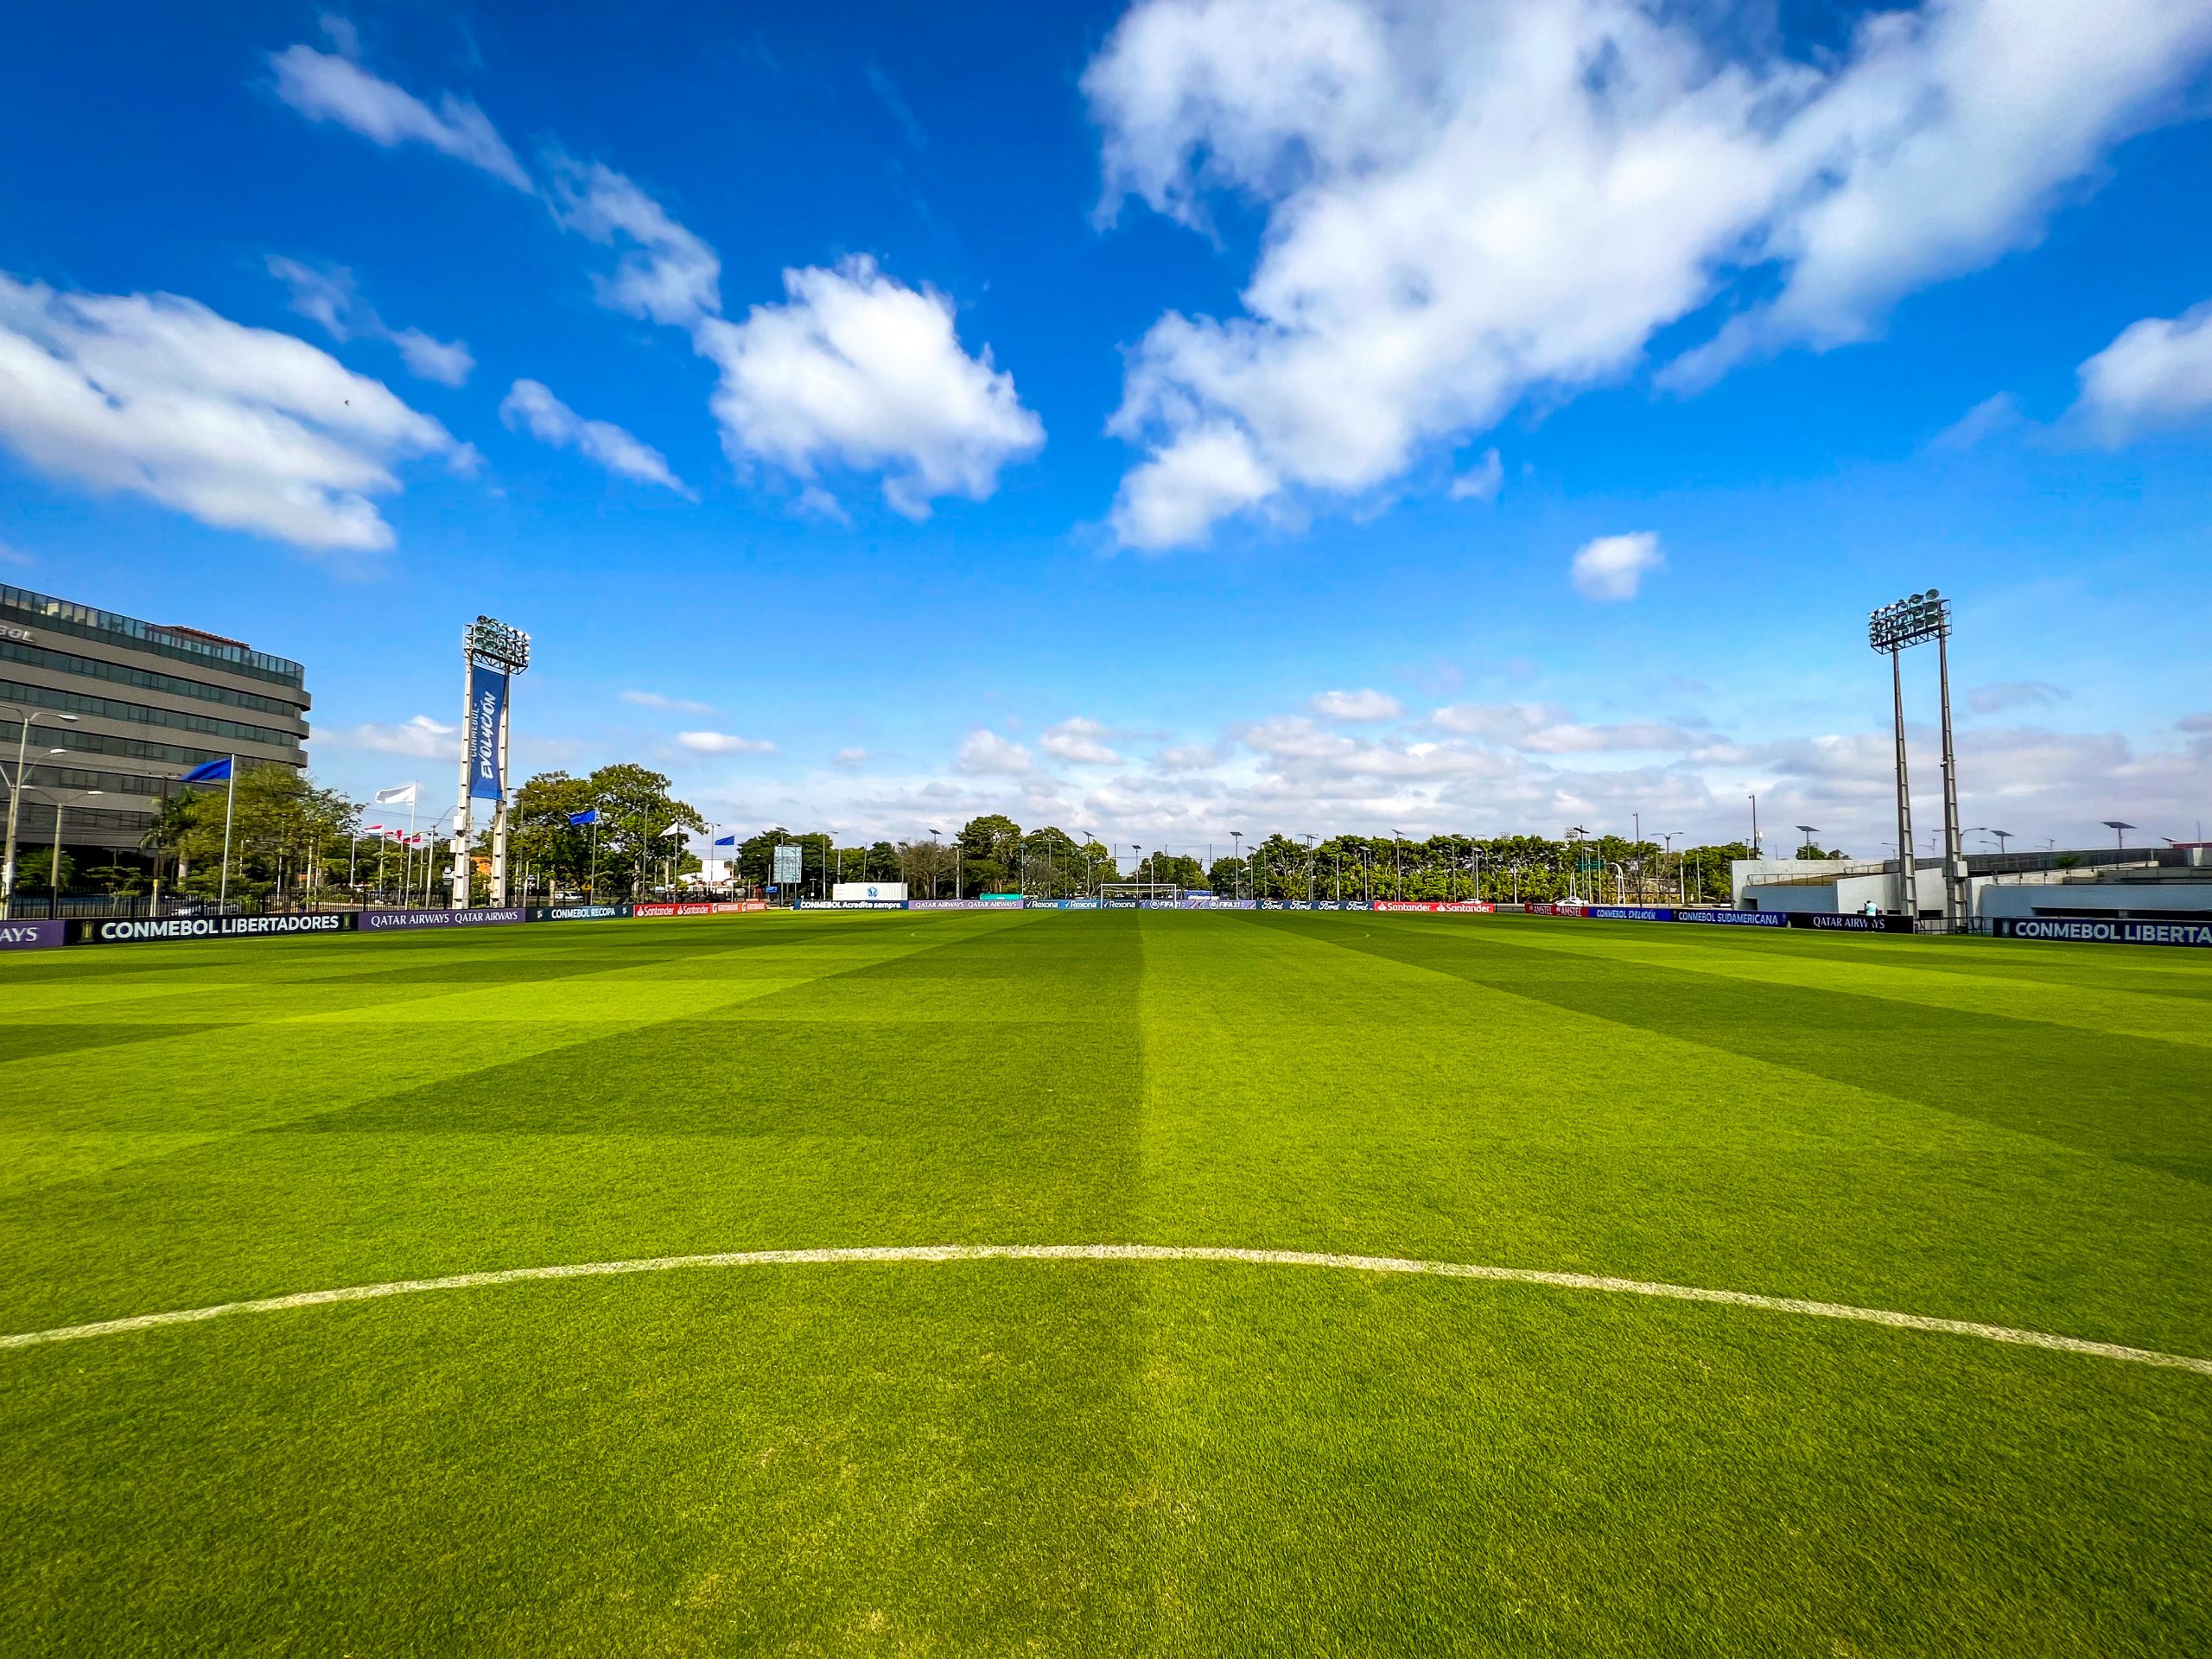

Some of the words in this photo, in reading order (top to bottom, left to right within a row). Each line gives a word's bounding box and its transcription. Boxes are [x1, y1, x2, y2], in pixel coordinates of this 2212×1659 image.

[842, 900, 873, 909] Acredite
[1262, 900, 1283, 909] Ford
[1289, 900, 1312, 910] Ford
[1318, 900, 1340, 910] Ford
[1346, 901, 1368, 910] Ford
[1388, 903, 1431, 912] Santander
[1446, 904, 1491, 912] Santander
[551, 908, 590, 919] CONMEBOL
[591, 907, 616, 917] RECOPA
[645, 906, 674, 916] Santander
[683, 905, 709, 915] Santander
[1534, 905, 1553, 915] AMSTEL
[1560, 906, 1582, 917] AMSTEL
[371, 914, 406, 928] QATAR
[408, 913, 449, 925] AIRWAYS
[454, 912, 483, 923] QATAR
[485, 911, 518, 921] AIRWAYS
[1679, 912, 1716, 922] CONMEBOL
[1717, 913, 1778, 925] SUDAMERICANA
[101, 918, 219, 939] CONMEBOL
[221, 915, 339, 934] LIBERTADORES
[1813, 916, 1842, 927] QATAR
[1844, 918, 1885, 929] AIRWYS
[2015, 922, 2120, 940] CONMEBOL
[2124, 925, 2212, 944] LIBERTA
